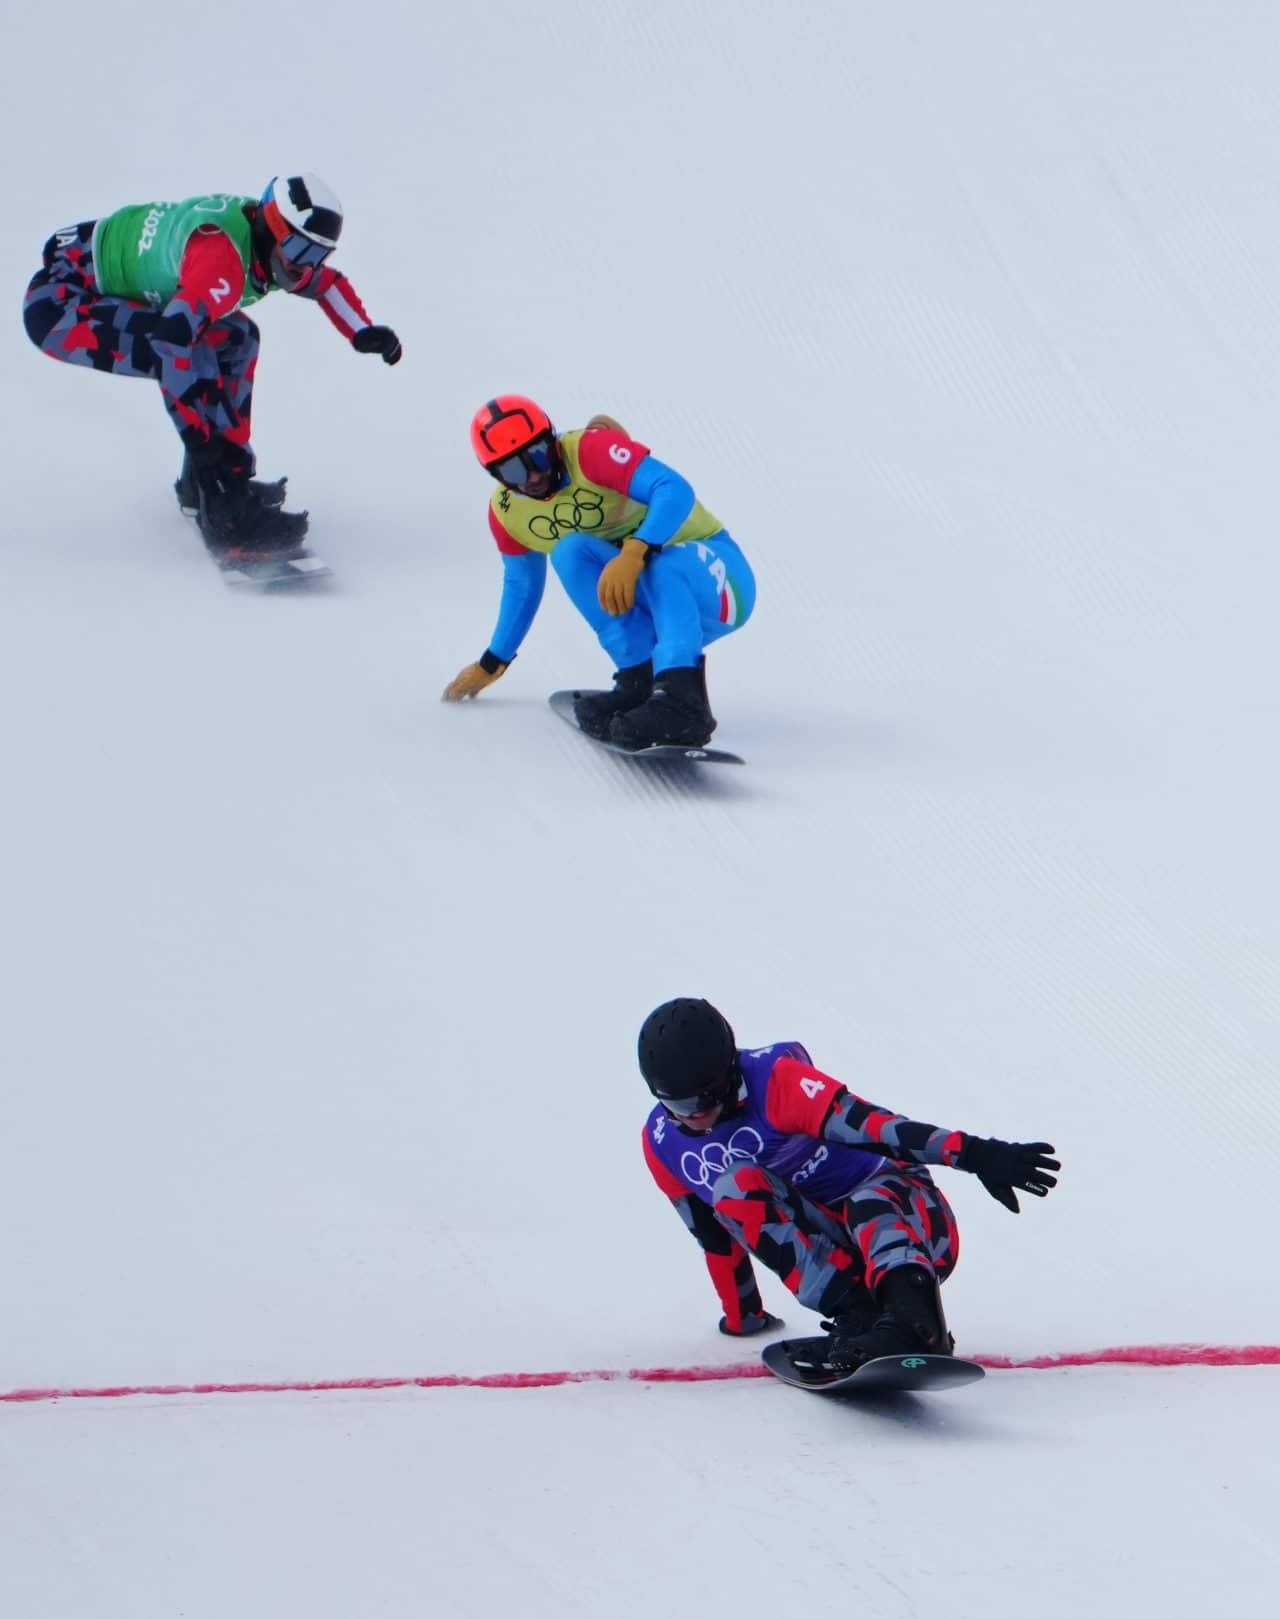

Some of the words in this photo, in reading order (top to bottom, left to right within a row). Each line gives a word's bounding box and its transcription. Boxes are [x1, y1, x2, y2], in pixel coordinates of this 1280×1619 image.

[138, 208, 165, 257] 2022
[209, 278, 231, 304] 2
[609, 444, 632, 464] 6
[799, 1077, 827, 1099] 4
